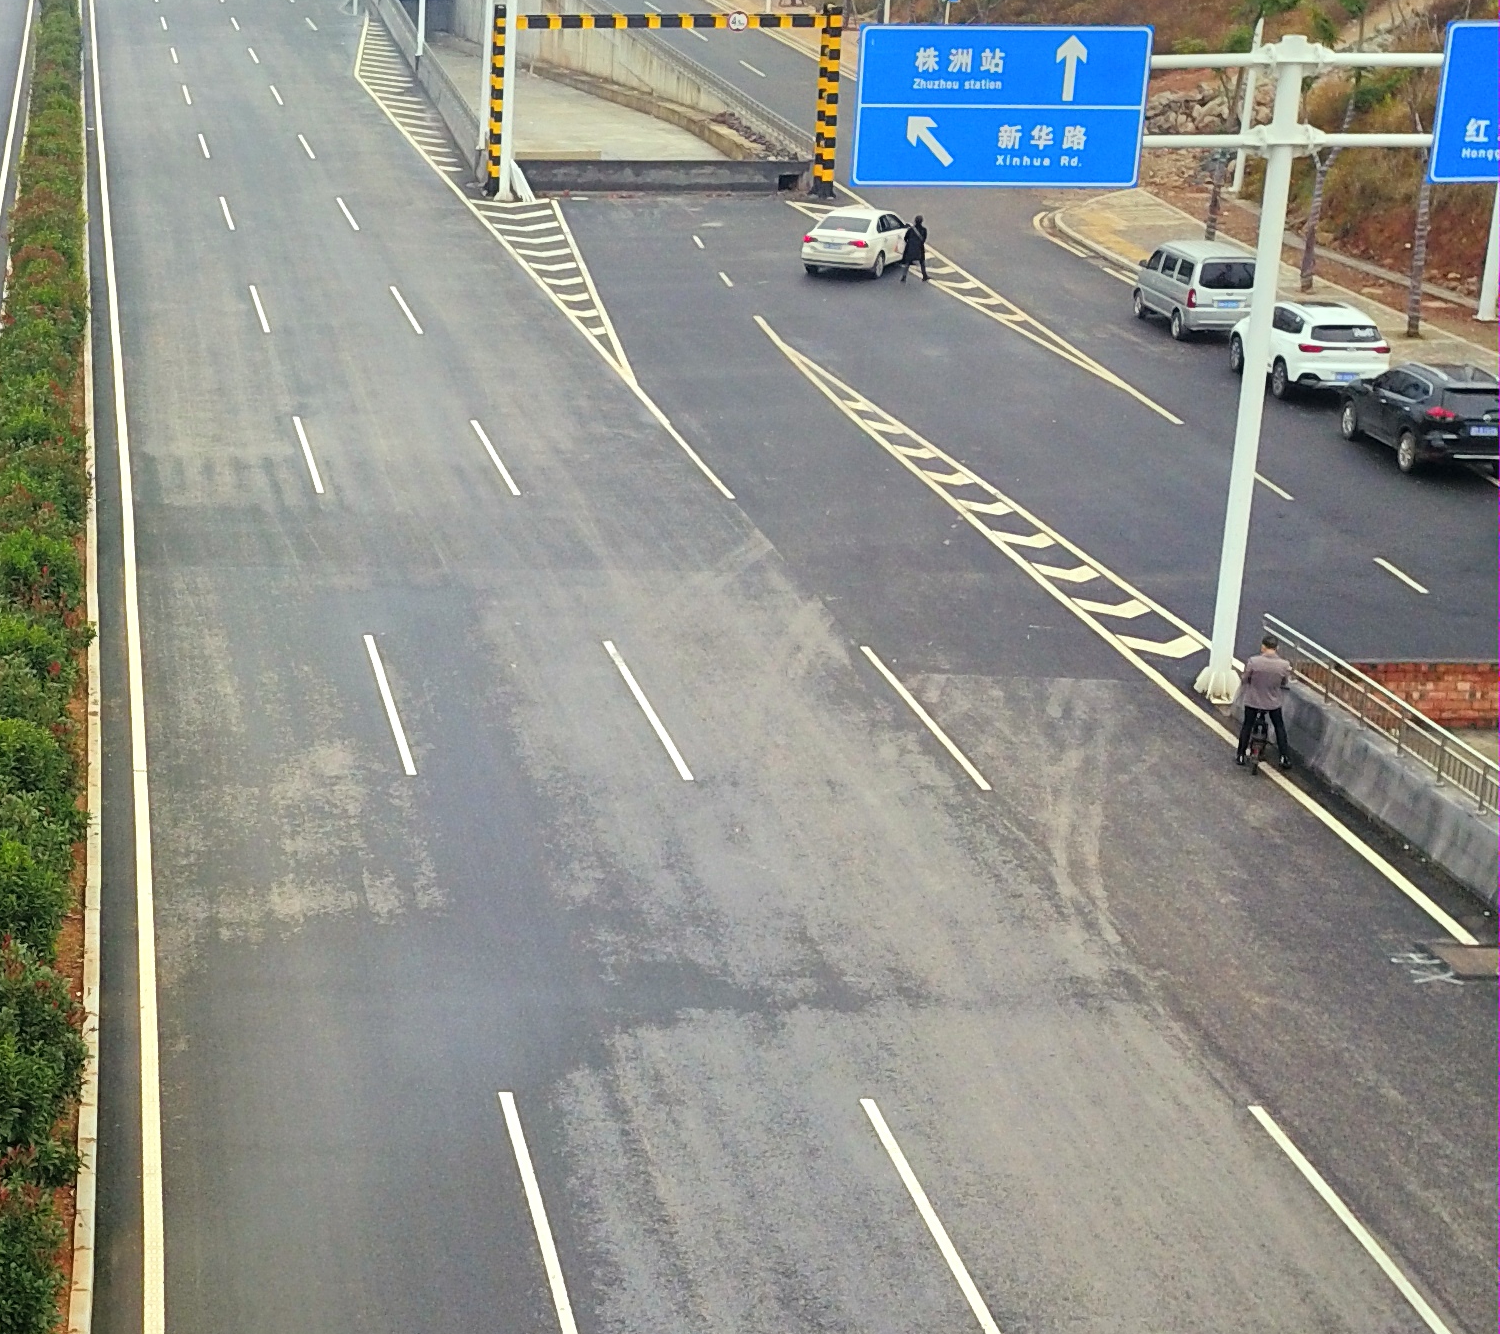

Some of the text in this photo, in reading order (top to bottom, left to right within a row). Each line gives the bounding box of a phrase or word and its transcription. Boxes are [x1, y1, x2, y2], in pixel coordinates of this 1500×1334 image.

[914, 47, 1005, 73] 株洲站
[913, 78, 1002, 89] Zhuzhou station
[997, 124, 1087, 150] 新华路
[996, 154, 1082, 167] Xinhua Rd.
